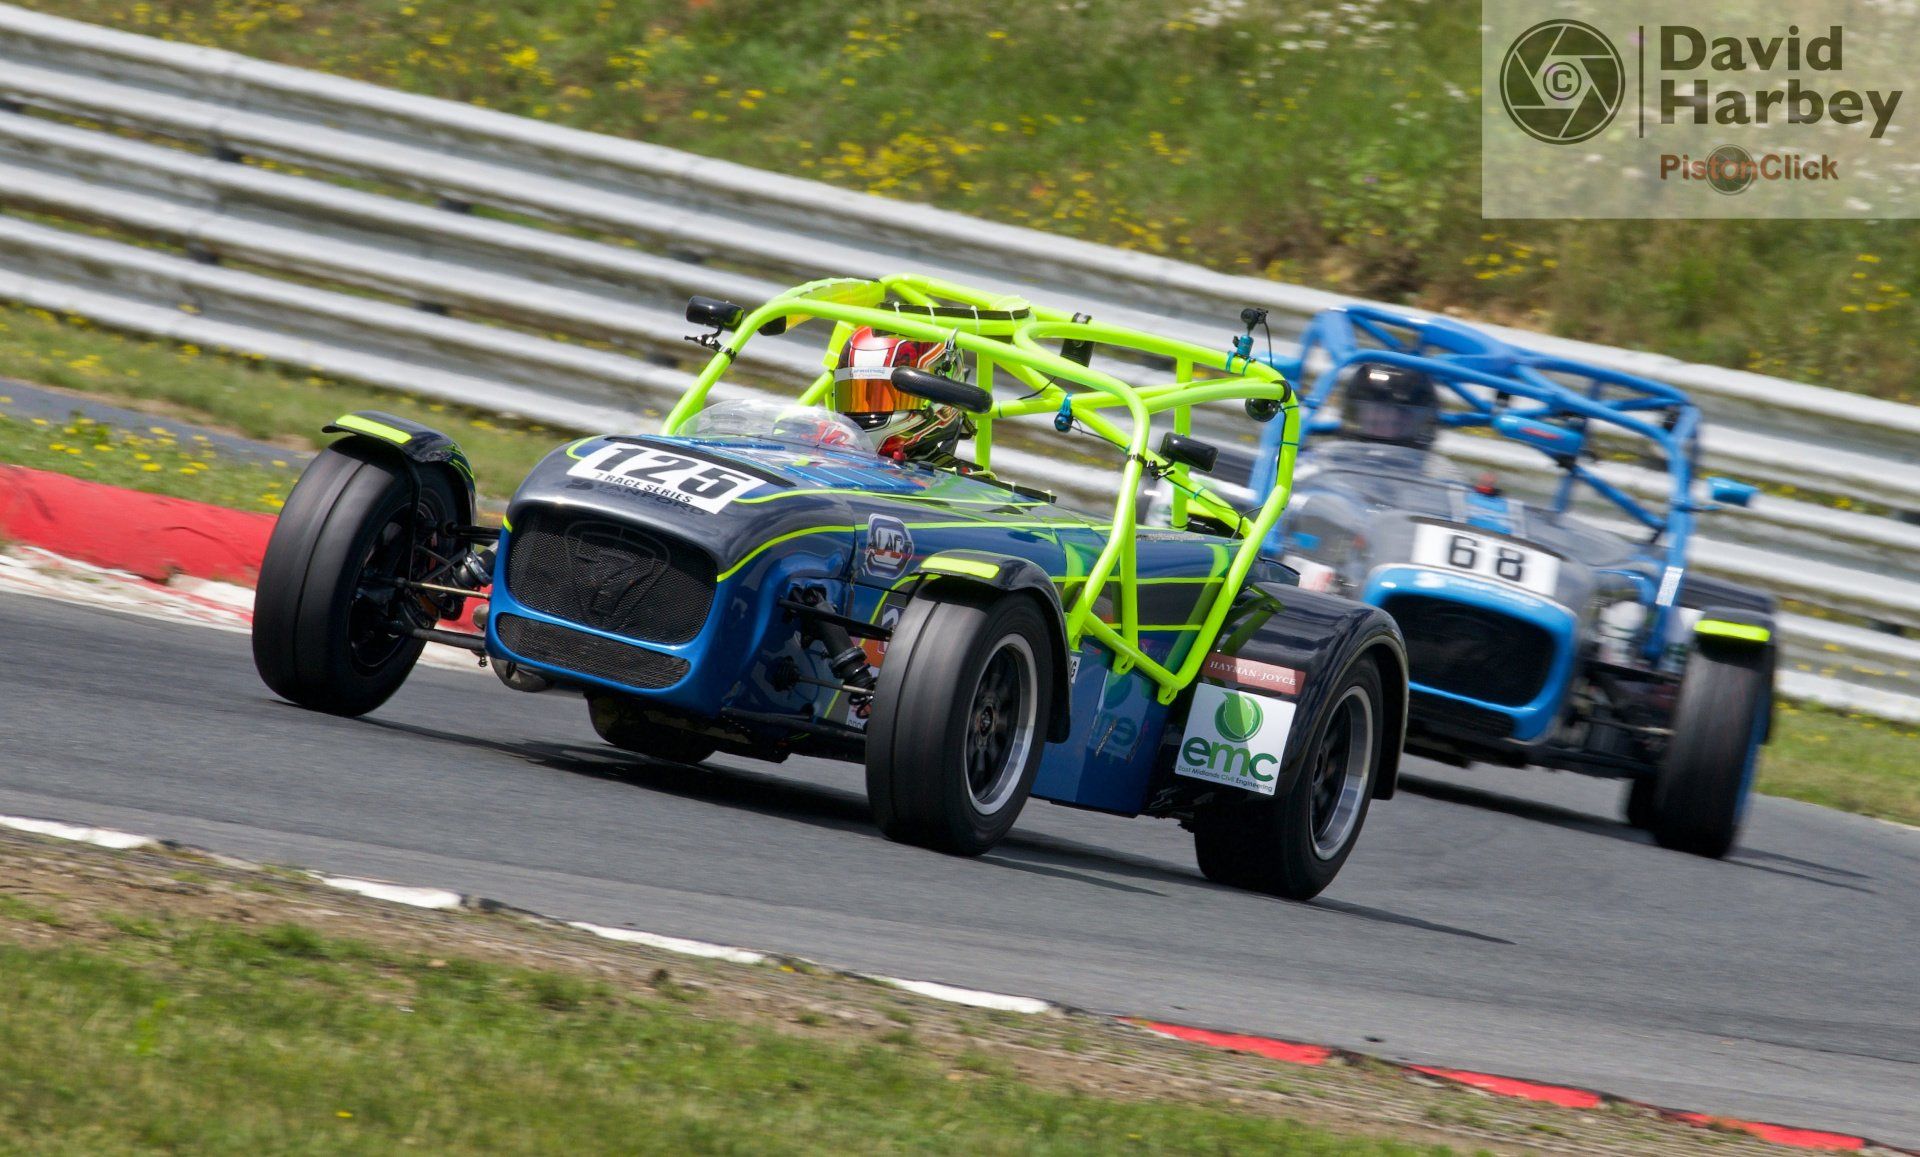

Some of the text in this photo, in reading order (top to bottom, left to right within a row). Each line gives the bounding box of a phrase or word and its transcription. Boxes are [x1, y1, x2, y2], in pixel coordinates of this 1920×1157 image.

[593, 447, 752, 499] 125
[606, 474, 640, 490] RACE
[643, 484, 694, 503] SERIES
[1448, 534, 1525, 582] 68
[1182, 736, 1279, 782] emc
[1191, 768, 1219, 779] Midlands
[1235, 776, 1273, 792] Engineering
